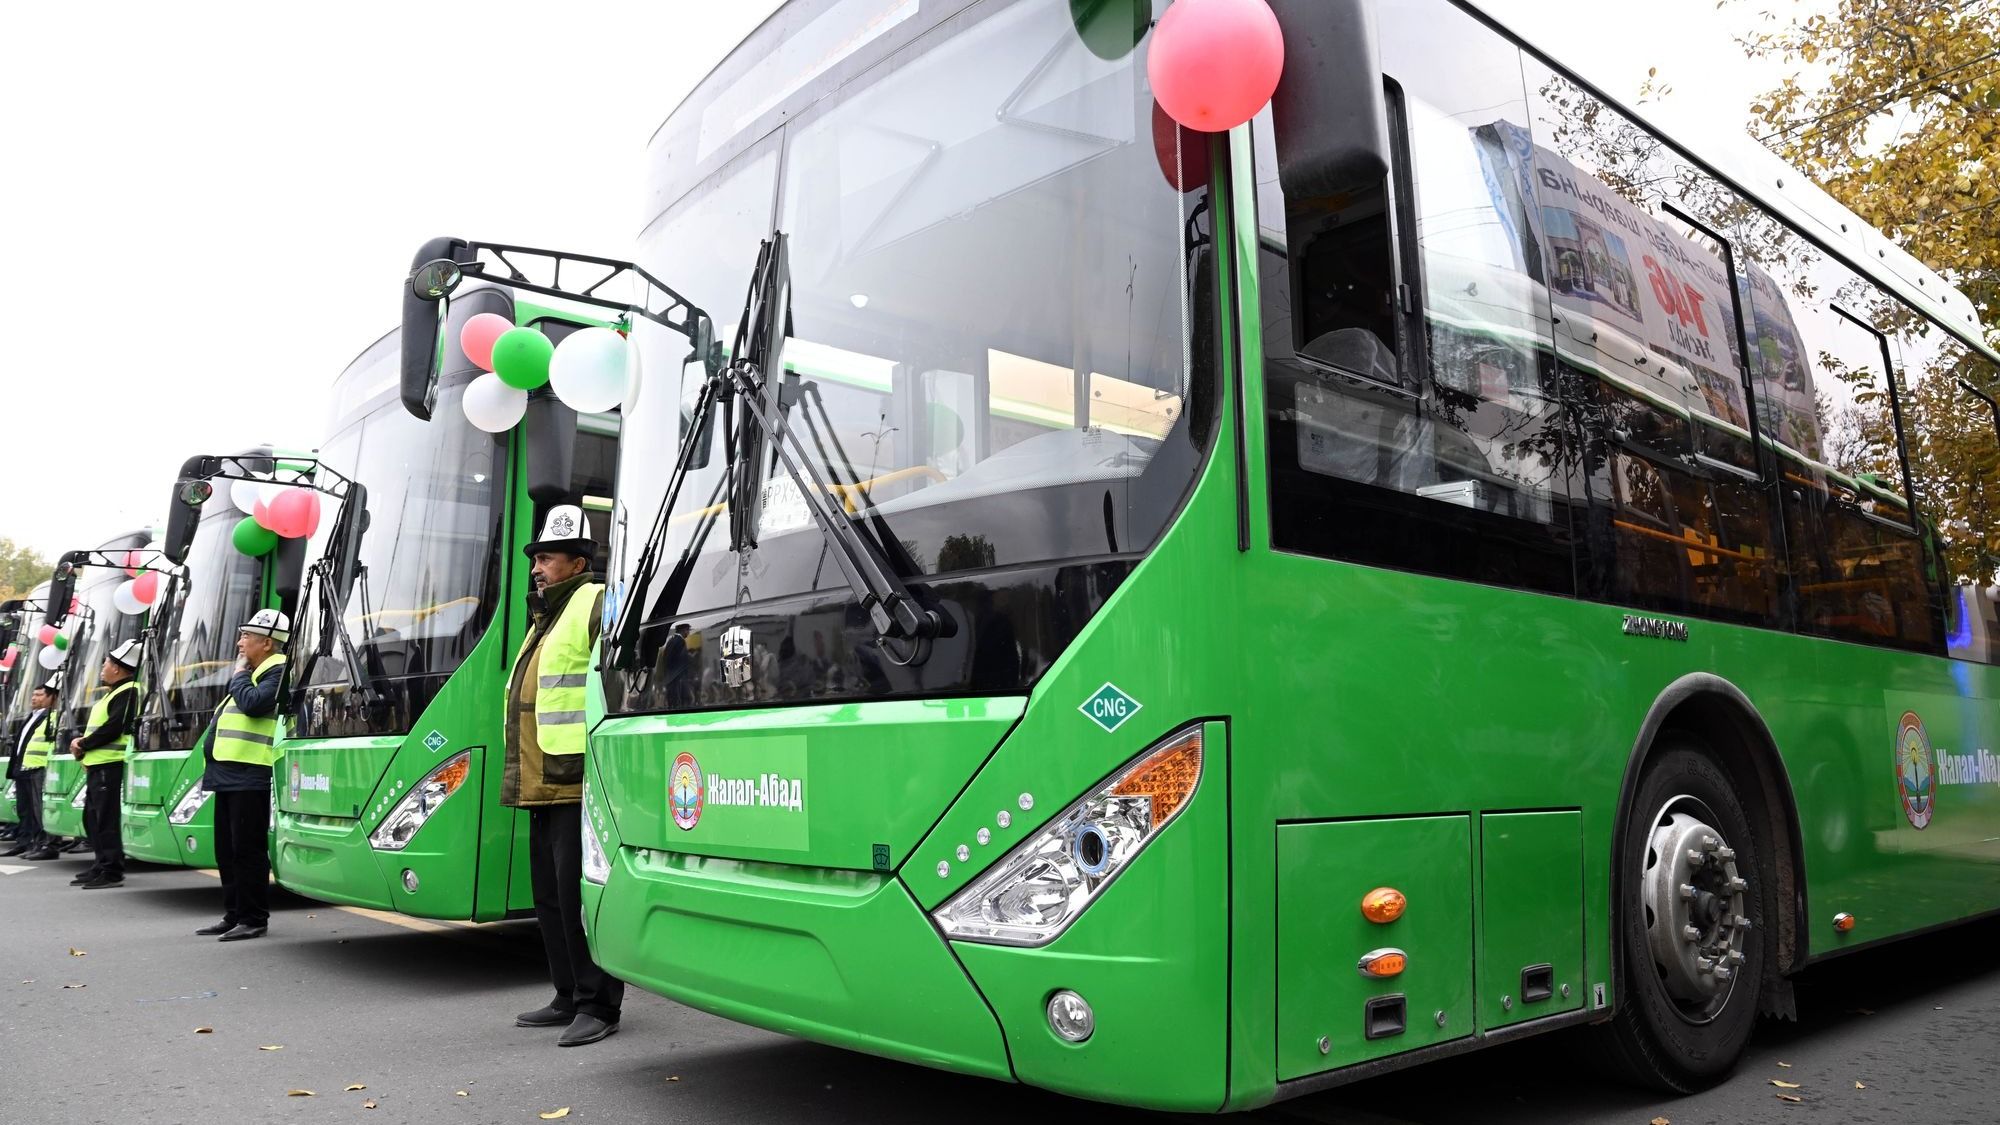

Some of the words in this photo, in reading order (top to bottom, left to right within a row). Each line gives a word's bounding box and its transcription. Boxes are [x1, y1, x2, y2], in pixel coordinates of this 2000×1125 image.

[1622, 614, 1689, 641] ZHONGTONG
[1093, 697, 1126, 718] CNG
[427, 736, 442, 746] CNG
[707, 773, 803, 813] Жалал-Абад
